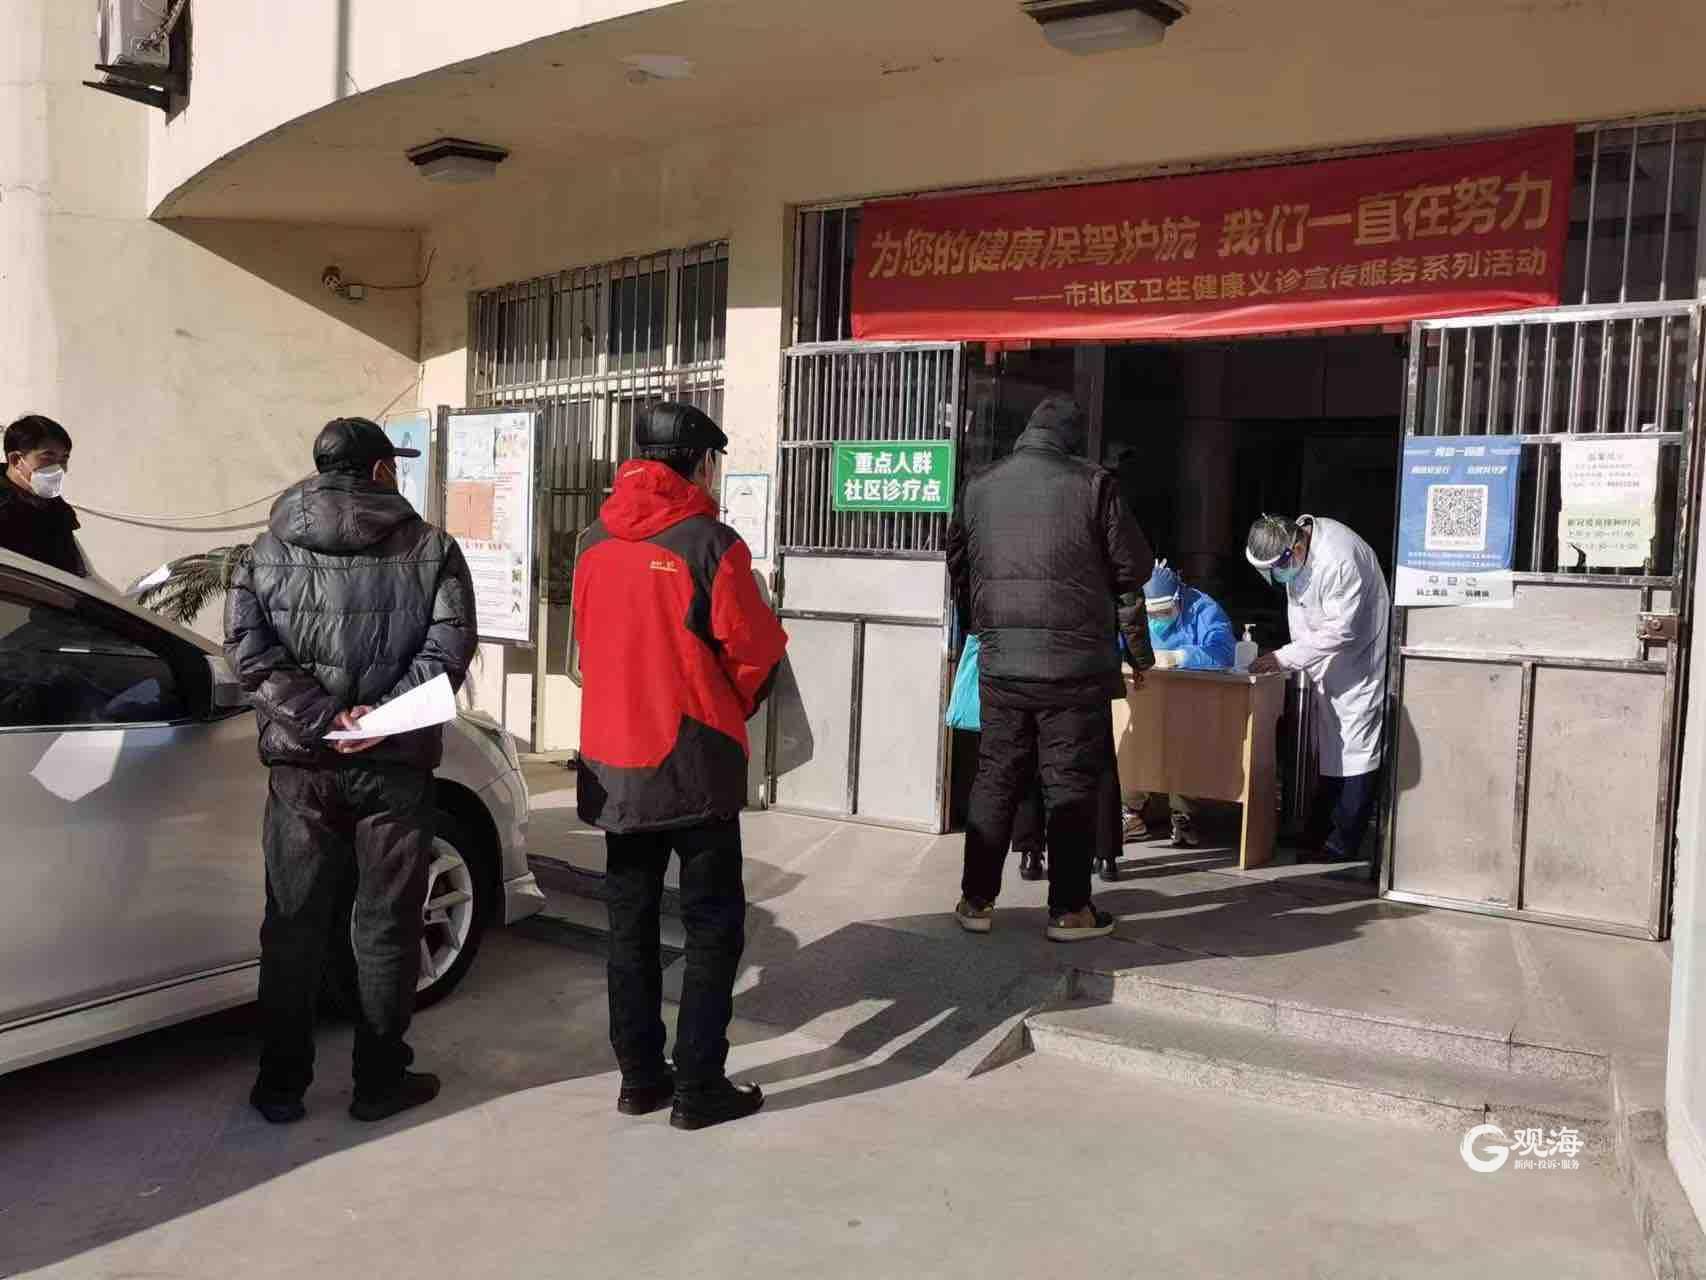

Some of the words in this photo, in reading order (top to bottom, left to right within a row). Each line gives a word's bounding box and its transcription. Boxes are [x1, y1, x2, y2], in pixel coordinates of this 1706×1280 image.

[868, 214, 1200, 279] 为您的健康保驾护航
[1217, 170, 1552, 257] 我们一直在努力
[854, 451, 933, 474] 重点人群
[844, 478, 941, 502] 社区诊疗点
